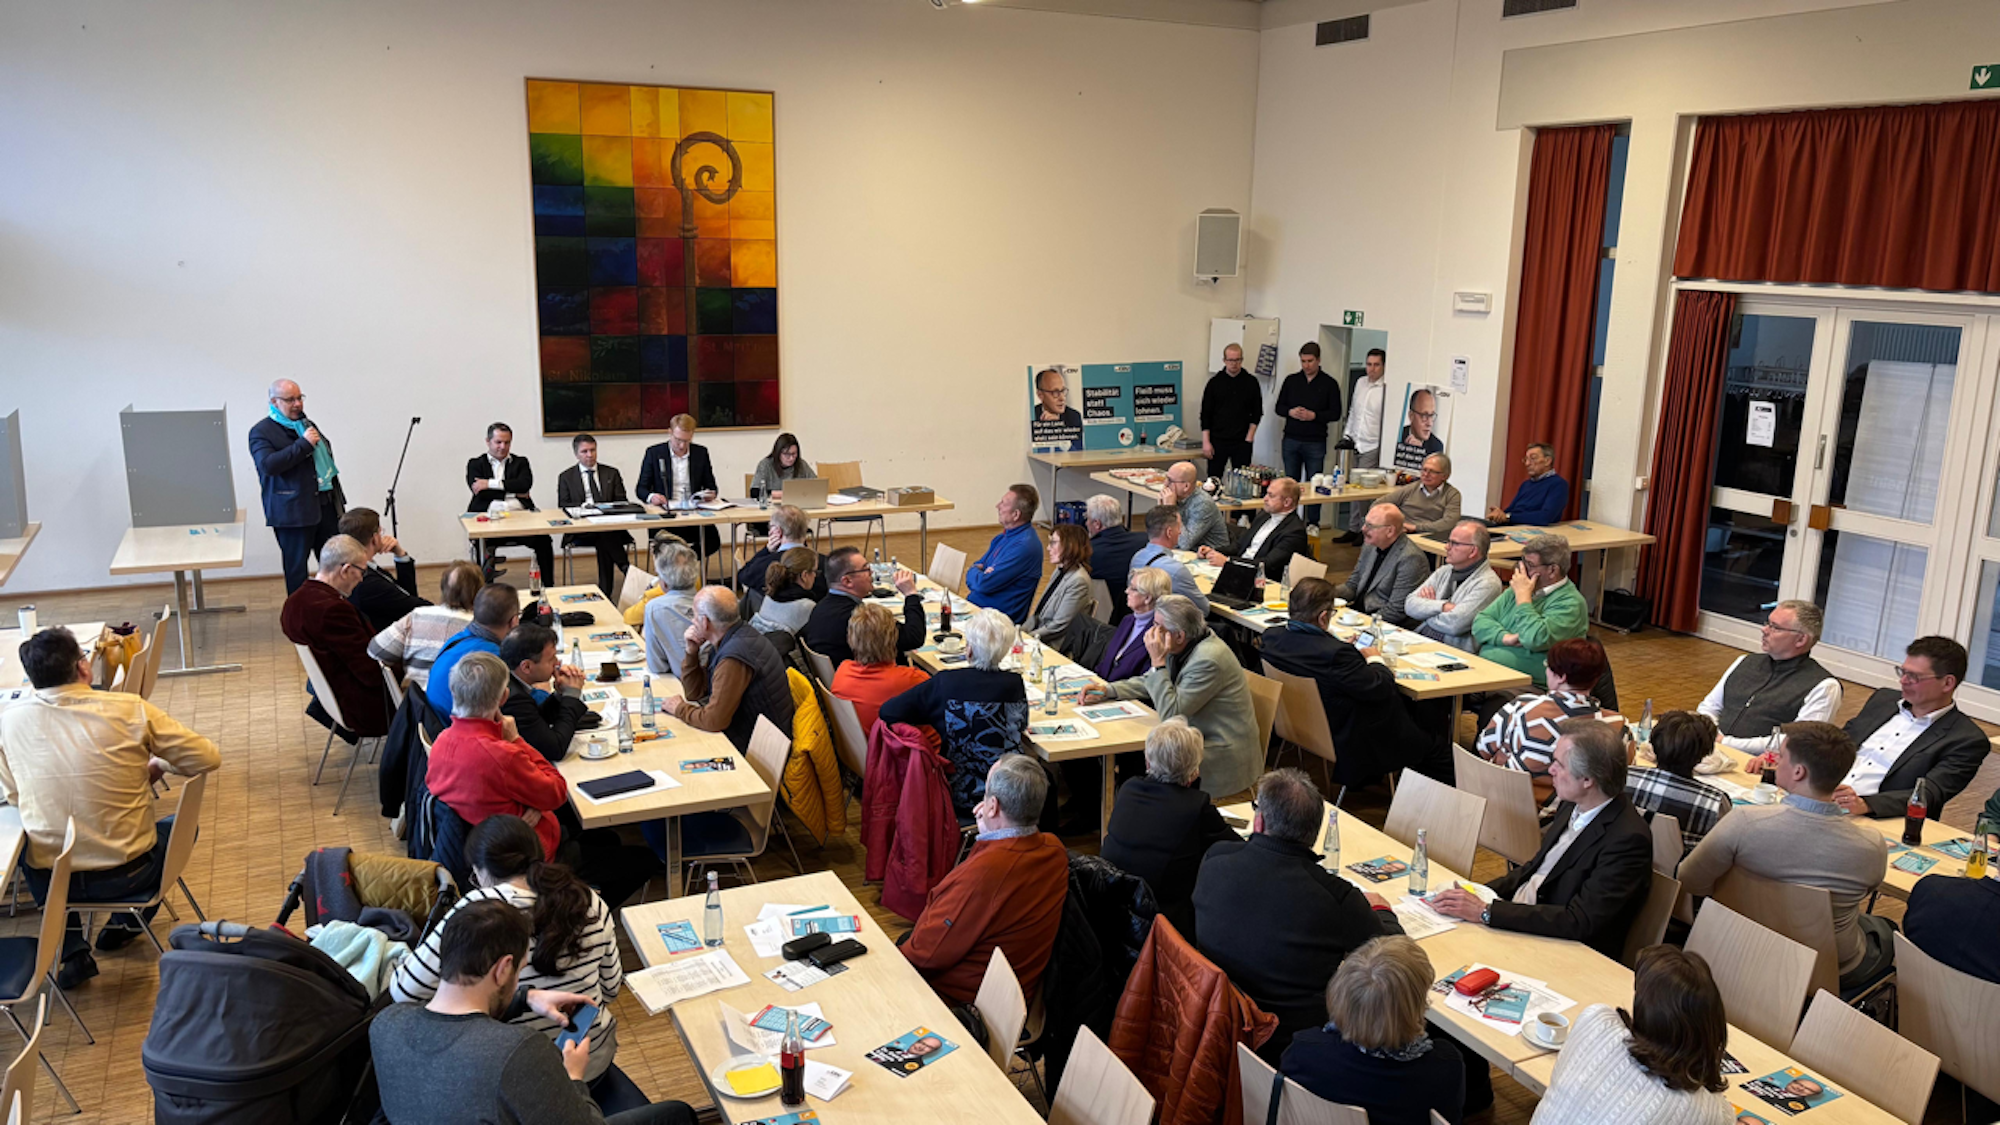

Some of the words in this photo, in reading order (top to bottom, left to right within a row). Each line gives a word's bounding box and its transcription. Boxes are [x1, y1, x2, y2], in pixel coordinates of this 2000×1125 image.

[1086, 388, 1120, 398] Stabilität
[1086, 399, 1105, 407] statt
[1135, 397, 1151, 405] sich
[1152, 395, 1176, 404] wieder
[1086, 408, 1113, 417] Chaos.
[1135, 406, 1162, 415] lohnen.
